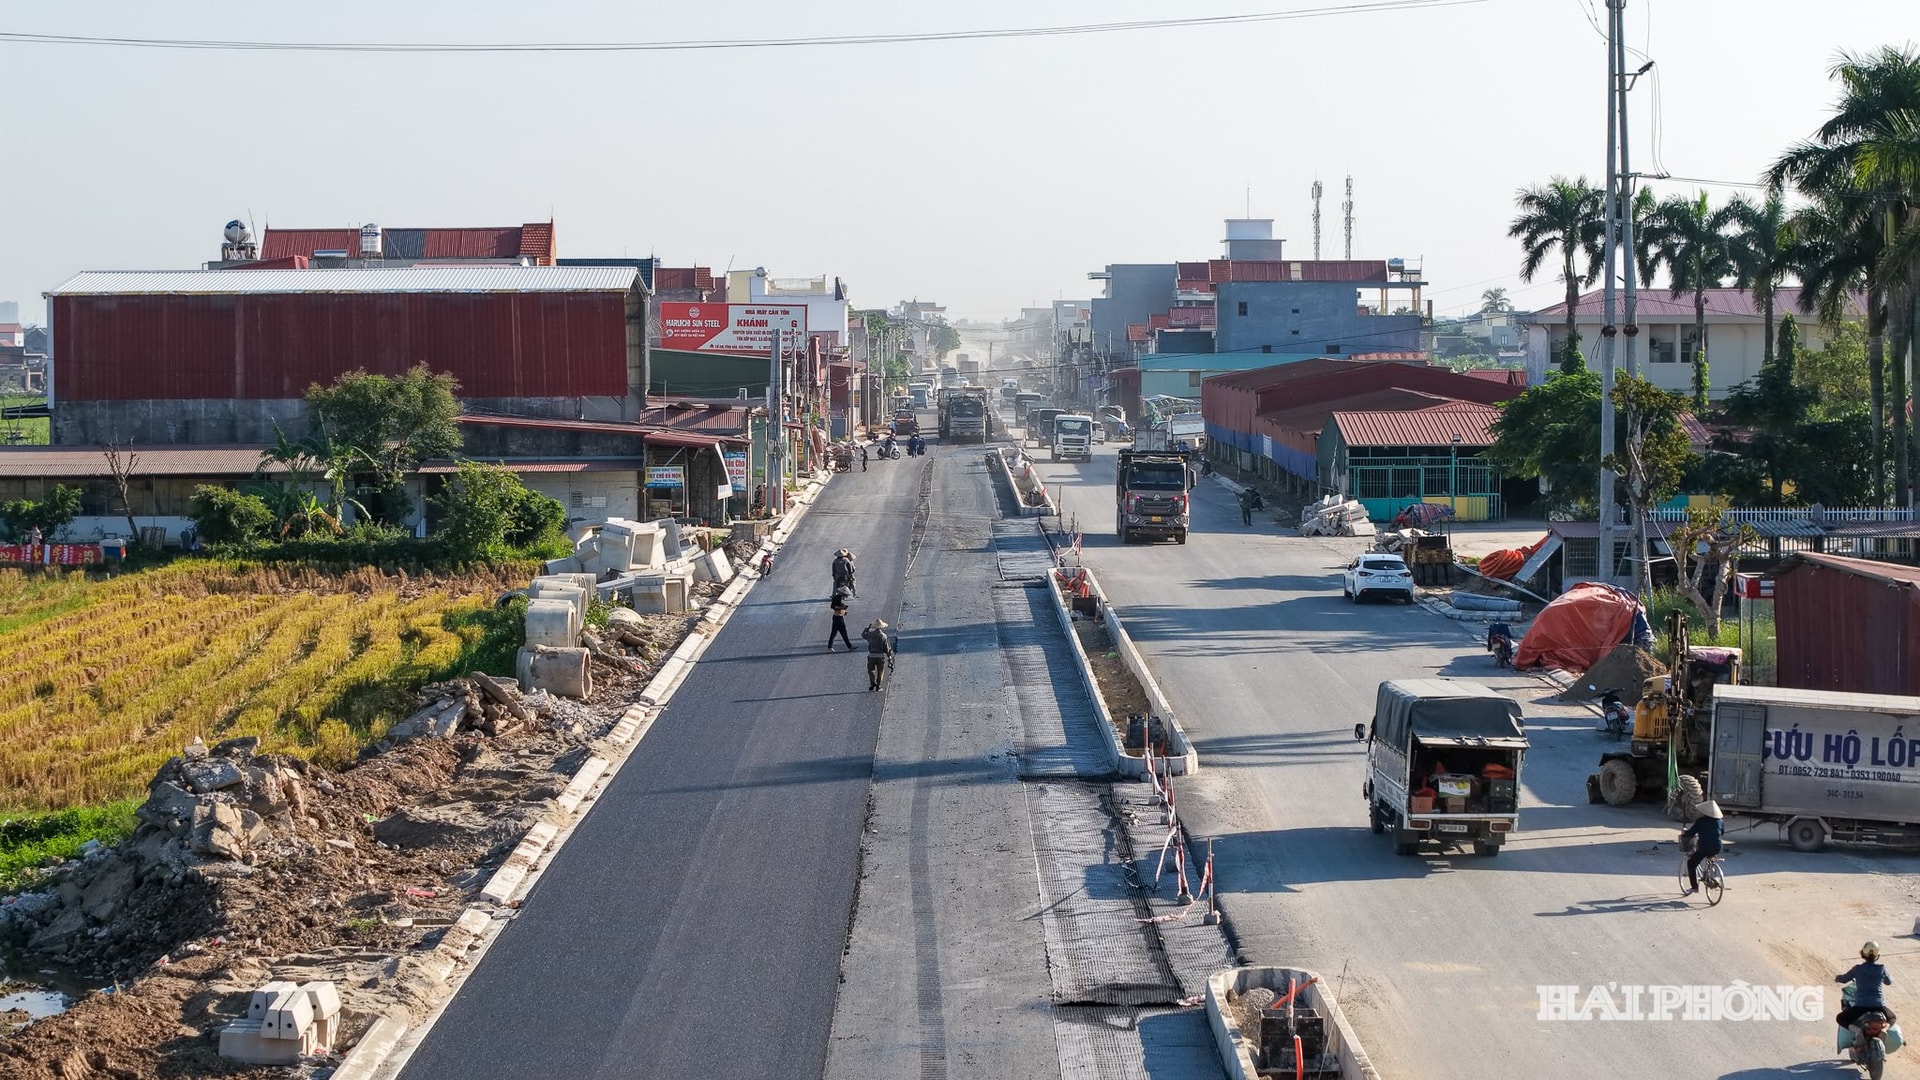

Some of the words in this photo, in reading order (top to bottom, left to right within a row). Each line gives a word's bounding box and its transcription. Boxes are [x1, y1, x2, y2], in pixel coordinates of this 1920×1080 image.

[692, 319, 703, 327] SUN
[704, 319, 720, 328] STEEL
[737, 317, 768, 327] KHÁNH
[1764, 723, 1813, 761] CỨU
[1823, 729, 1861, 769] HỘ
[1871, 725, 1920, 768] LỐP
[1814, 767, 1828, 778] 729
[1830, 768, 1844, 778] 841
[1851, 770, 1870, 780] 0353
[1872, 771, 1901, 783] 190040
